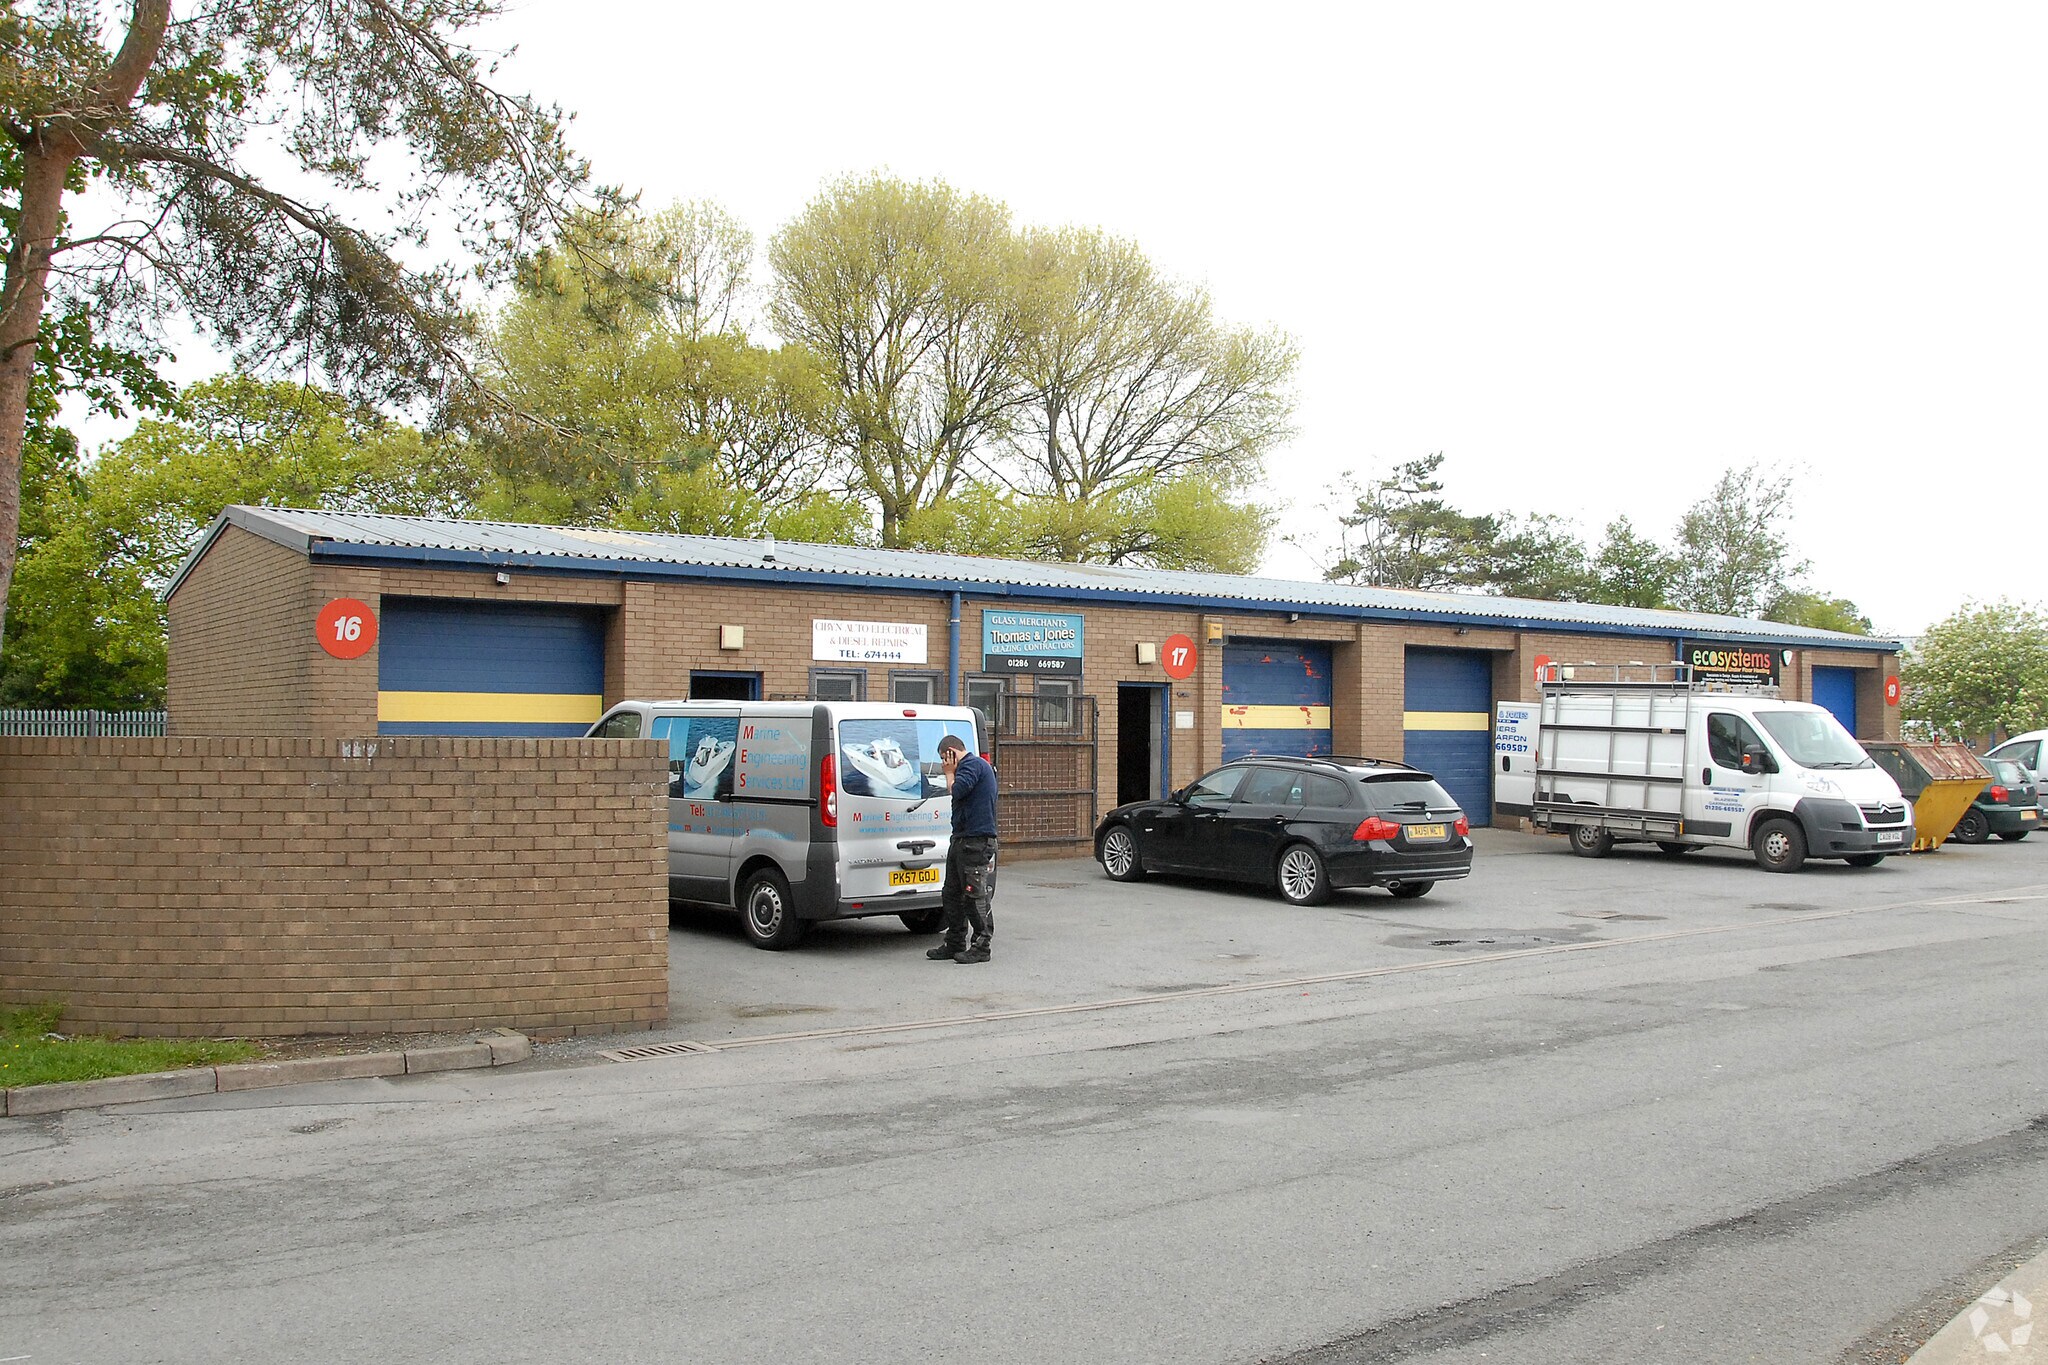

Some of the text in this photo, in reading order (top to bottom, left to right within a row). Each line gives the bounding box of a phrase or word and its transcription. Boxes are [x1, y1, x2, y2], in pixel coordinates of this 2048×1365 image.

[991, 616, 1067, 627] GLASS MERCHANTS
[334, 616, 362, 641] 16
[845, 623, 869, 633] AUTO
[871, 625, 924, 635] ELECTRICAL
[991, 627, 1075, 643] Thomas & Jones
[829, 637, 908, 647] & DIESEL REPAIRS
[991, 641, 1075, 653] GLAZING CONTRACTORS
[839, 649, 901, 659] TEL: 674444
[1171, 647, 1188, 666] 17
[1692, 648, 1771, 671] ecosystems
[1007, 659, 1065, 668] 01286 669587
[1888, 684, 1896, 697] 19
[1505, 711, 1528, 719] JONES
[743, 725, 781, 740] Marine
[741, 749, 807, 769] Engineering
[739, 773, 805, 790] Services Ltd
[690, 804, 705, 817] Tel:
[885, 811, 932, 823] Engineering
[893, 870, 936, 884] PK57 GOJ
